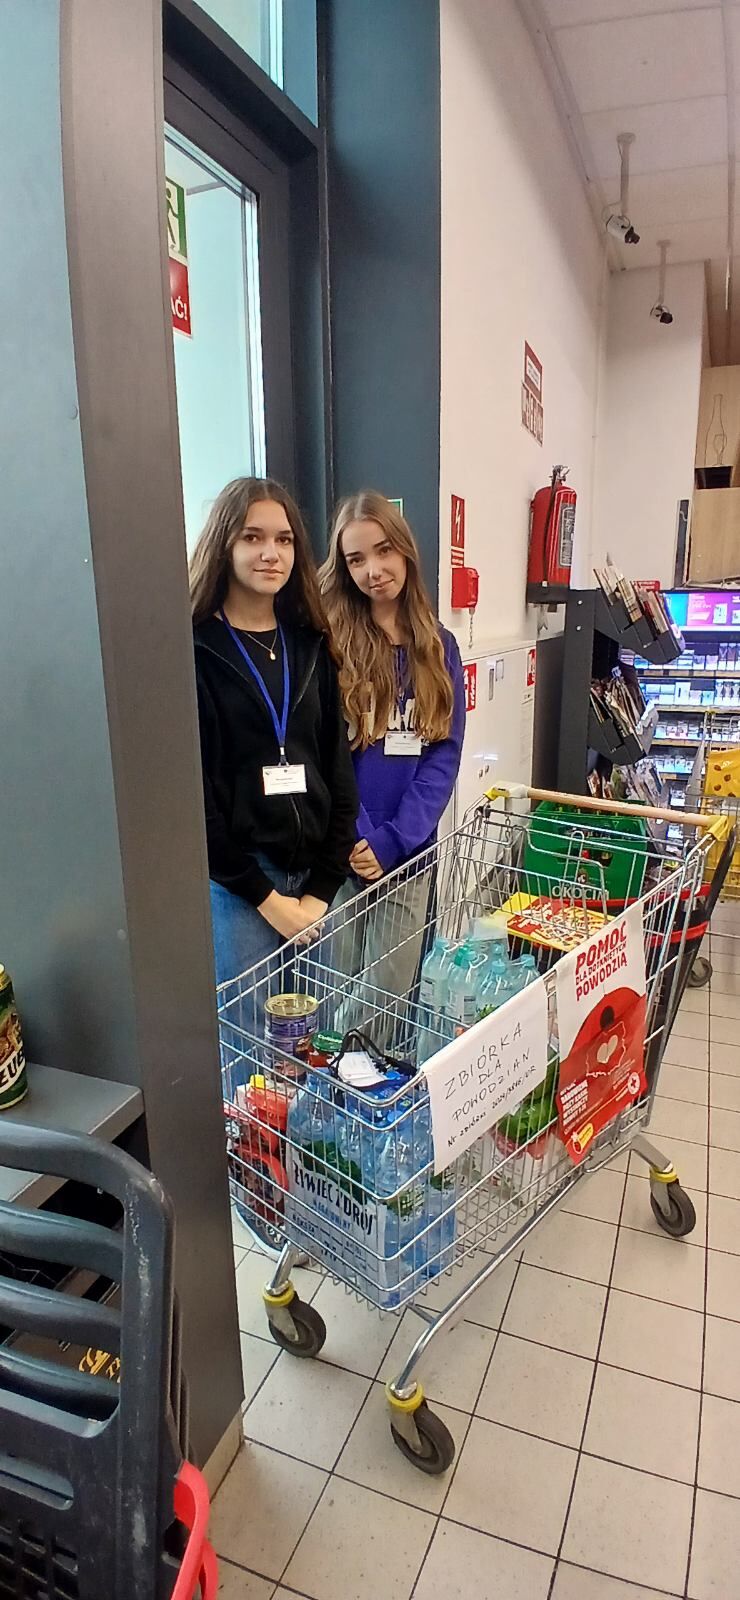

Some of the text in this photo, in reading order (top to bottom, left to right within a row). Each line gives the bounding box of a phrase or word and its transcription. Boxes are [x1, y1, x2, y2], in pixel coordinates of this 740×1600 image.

[576, 921, 627, 975] POMOC
[576, 952, 628, 1002] POWODZIĄ
[576, 971, 588, 986] DLA
[444, 1022, 521, 1100] ZBIÓRKA
[453, 1048, 530, 1121] POWODZIAN
[478, 1060, 501, 1085] DLA
